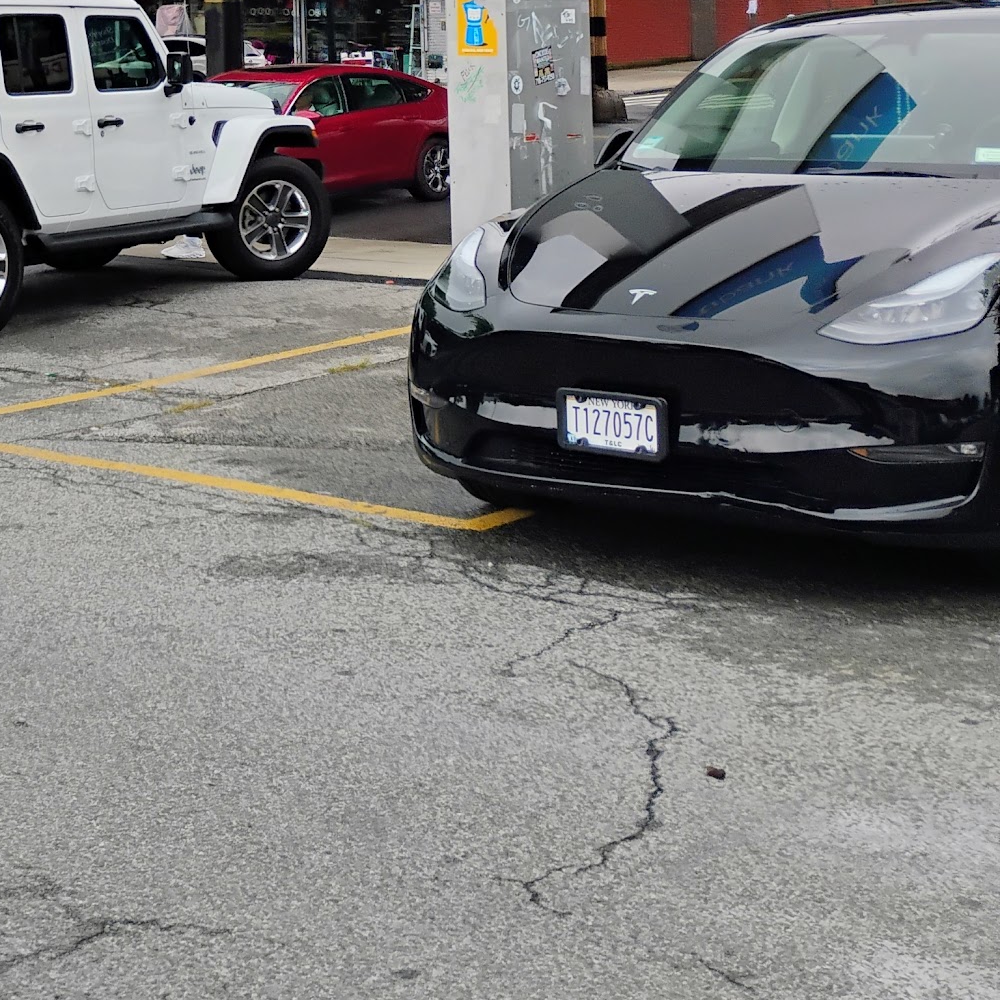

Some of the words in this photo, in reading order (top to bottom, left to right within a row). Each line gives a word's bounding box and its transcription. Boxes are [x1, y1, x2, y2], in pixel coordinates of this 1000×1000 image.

[588, 398, 609, 407] NEW
[572, 405, 654, 442] T127057C
[604, 439, 622, 448] T&LC
